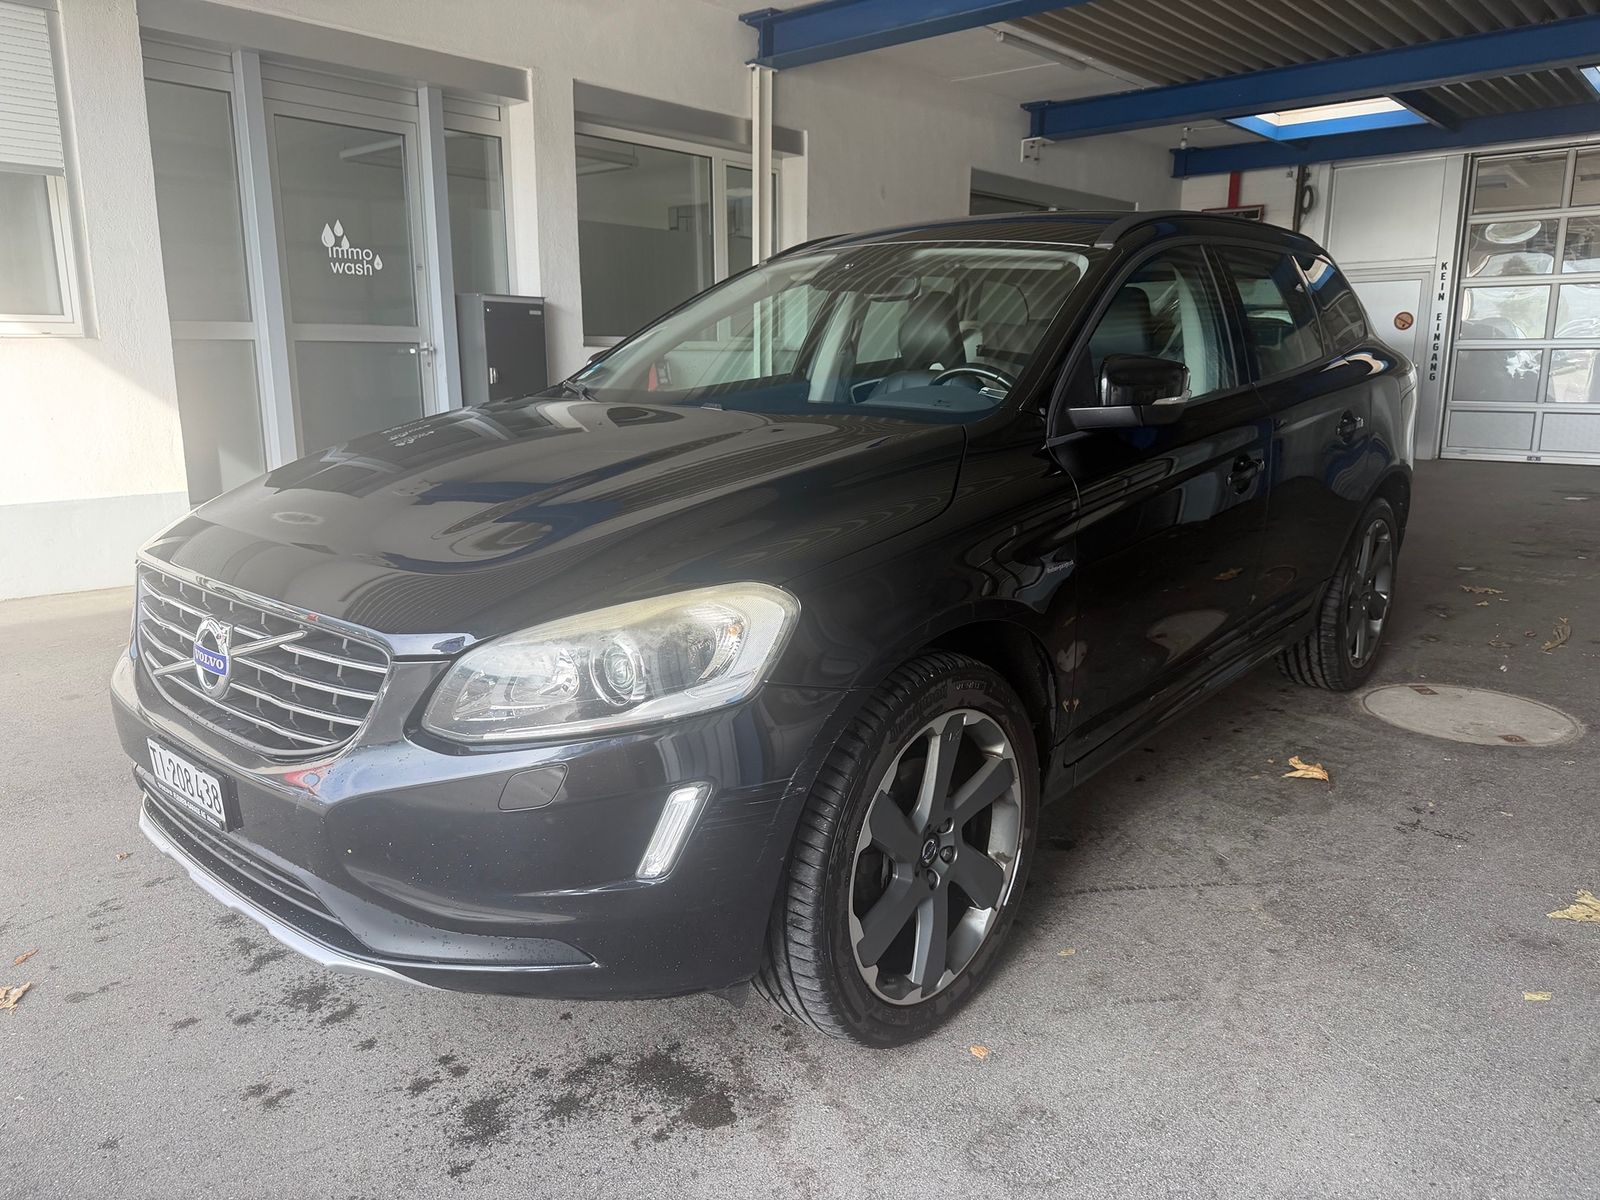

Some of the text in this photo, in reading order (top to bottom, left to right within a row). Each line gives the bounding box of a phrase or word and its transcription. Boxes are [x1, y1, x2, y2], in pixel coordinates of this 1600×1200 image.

[328, 246, 373, 261] immo
[330, 260, 373, 276] wash
[1429, 261, 1448, 381] KEIN EINGANG
[194, 648, 224, 670] VOLVO
